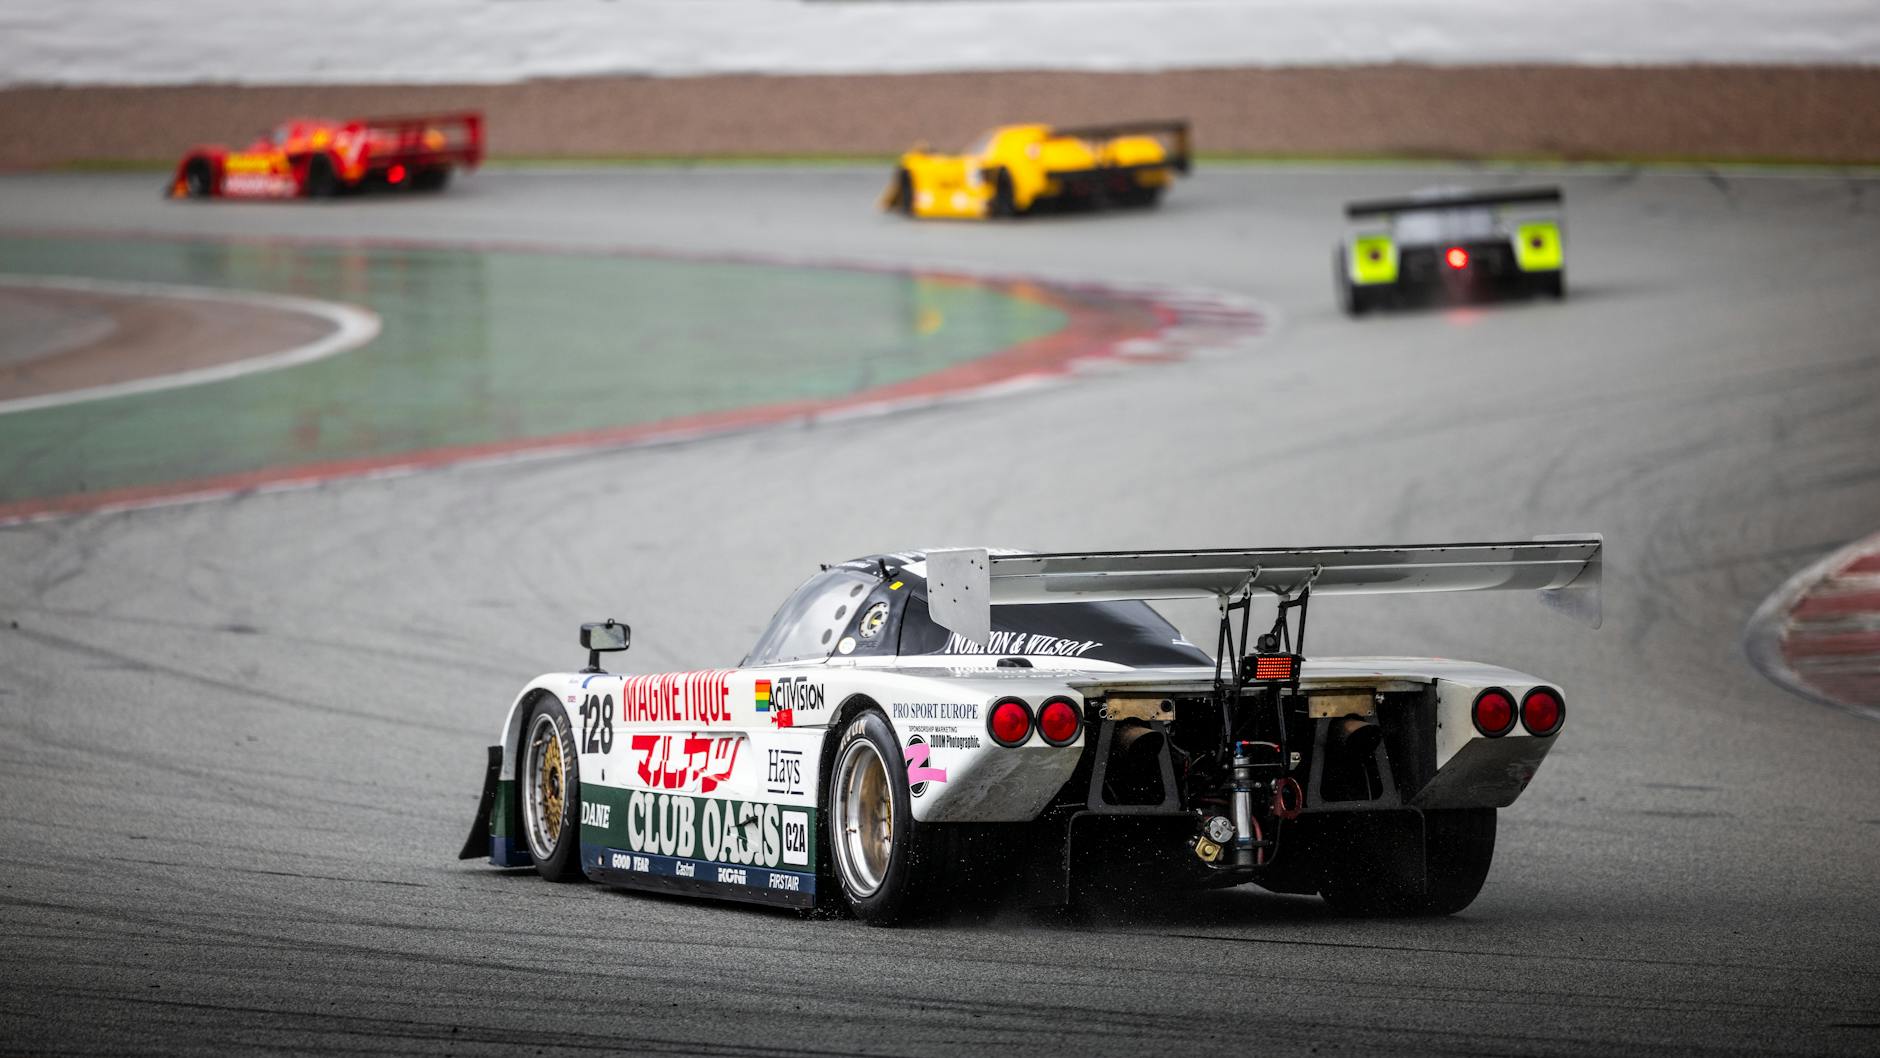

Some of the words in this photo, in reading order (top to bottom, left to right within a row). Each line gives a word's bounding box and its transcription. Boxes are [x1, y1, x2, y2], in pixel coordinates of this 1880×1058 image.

[1009, 633, 1027, 654] &
[1024, 633, 1103, 656] WILSON
[623, 670, 737, 726] MAGNETIQUE
[768, 676, 825, 711] ACTIVISION
[579, 694, 614, 754] 128
[893, 703, 909, 719] PRO
[910, 703, 939, 719] SPORT
[940, 703, 979, 720] EUROPE
[935, 726, 957, 734] MARKETING
[768, 749, 801, 794] Hays
[581, 801, 611, 829] DANE
[627, 790, 696, 858] CLUB
[701, 798, 781, 868] OASIS
[785, 822, 806, 853] C2A
[612, 853, 631, 870] GOOD
[633, 857, 650, 873] YEAR
[717, 867, 747, 885] KONI
[768, 873, 800, 891] FIRSTAIR
